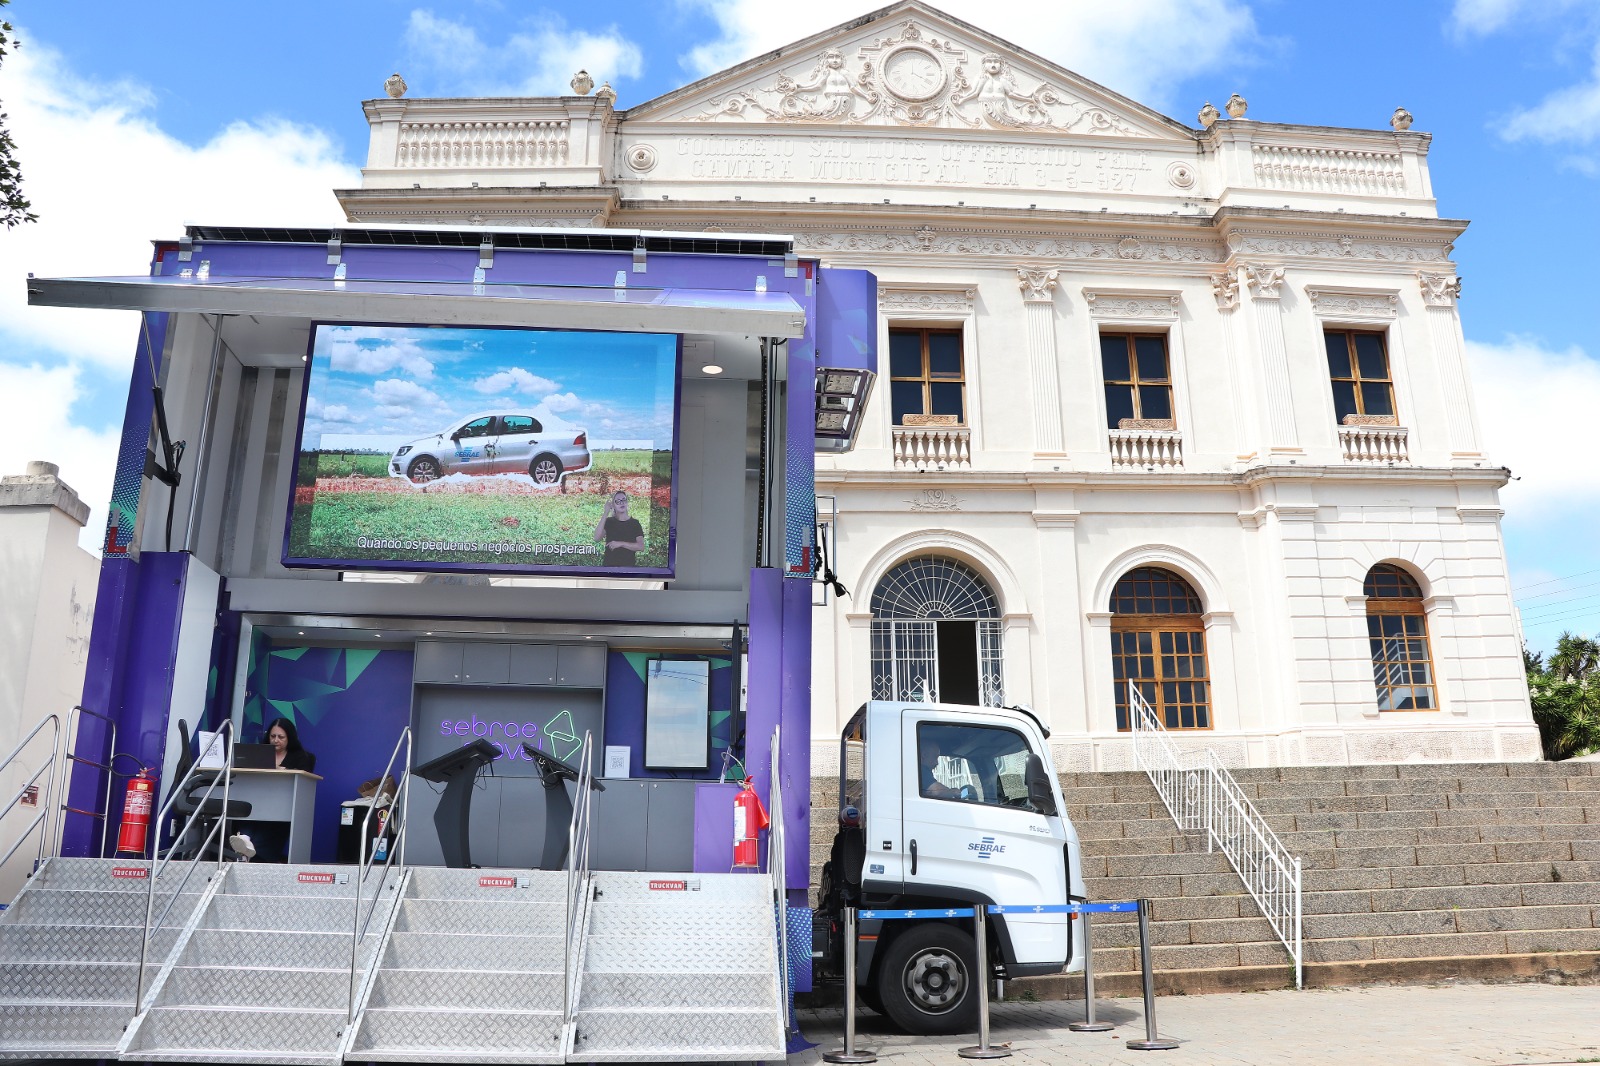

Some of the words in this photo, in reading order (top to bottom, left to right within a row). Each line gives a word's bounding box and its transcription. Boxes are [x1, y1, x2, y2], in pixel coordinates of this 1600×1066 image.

[939, 145, 1082, 168] OFFERECIDO
[1094, 150, 1153, 172] PELA
[809, 161, 969, 184] MUNICIPAL
[983, 166, 1020, 187] EM
[356, 537, 403, 549] Quando
[404, 539, 420, 550] os
[480, 540, 532, 555] negócios
[534, 543, 600, 556] prosperam,
[440, 713, 538, 738] sebrae
[967, 842, 1007, 854] SEBRAE
[113, 869, 146, 877] TRUCKVAN
[298, 874, 331, 882] TRUCKVAN
